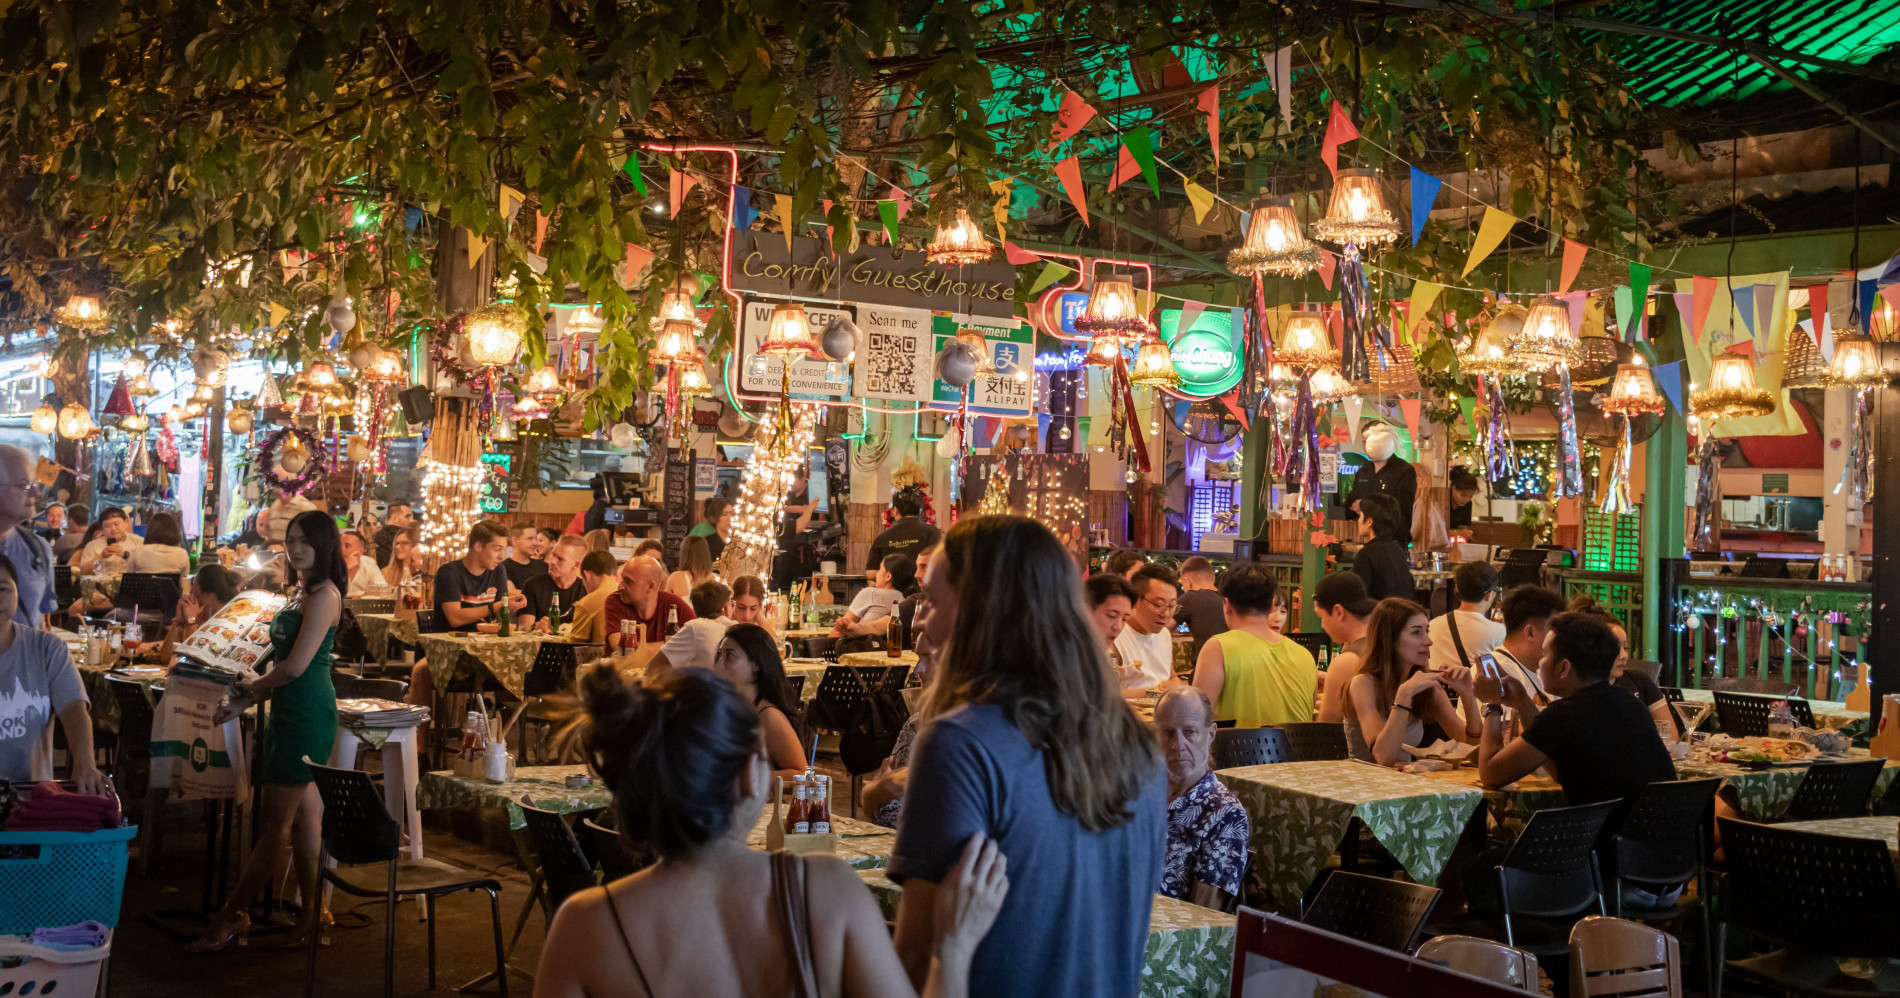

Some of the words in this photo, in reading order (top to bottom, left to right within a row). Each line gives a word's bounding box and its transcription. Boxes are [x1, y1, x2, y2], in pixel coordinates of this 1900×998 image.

[743, 251, 837, 294] Comfy
[851, 257, 1015, 301] Guesthouse
[755, 307, 773, 322] W
[869, 311, 897, 327] Scan
[901, 319, 918, 329] me
[791, 367, 797, 376] &
[800, 368, 826, 377] CREDIT
[748, 377, 763, 385] FOR
[767, 379, 789, 387] YOU
[791, 380, 843, 391] CONVENIENCE
[986, 395, 1025, 405] ALIPAY
